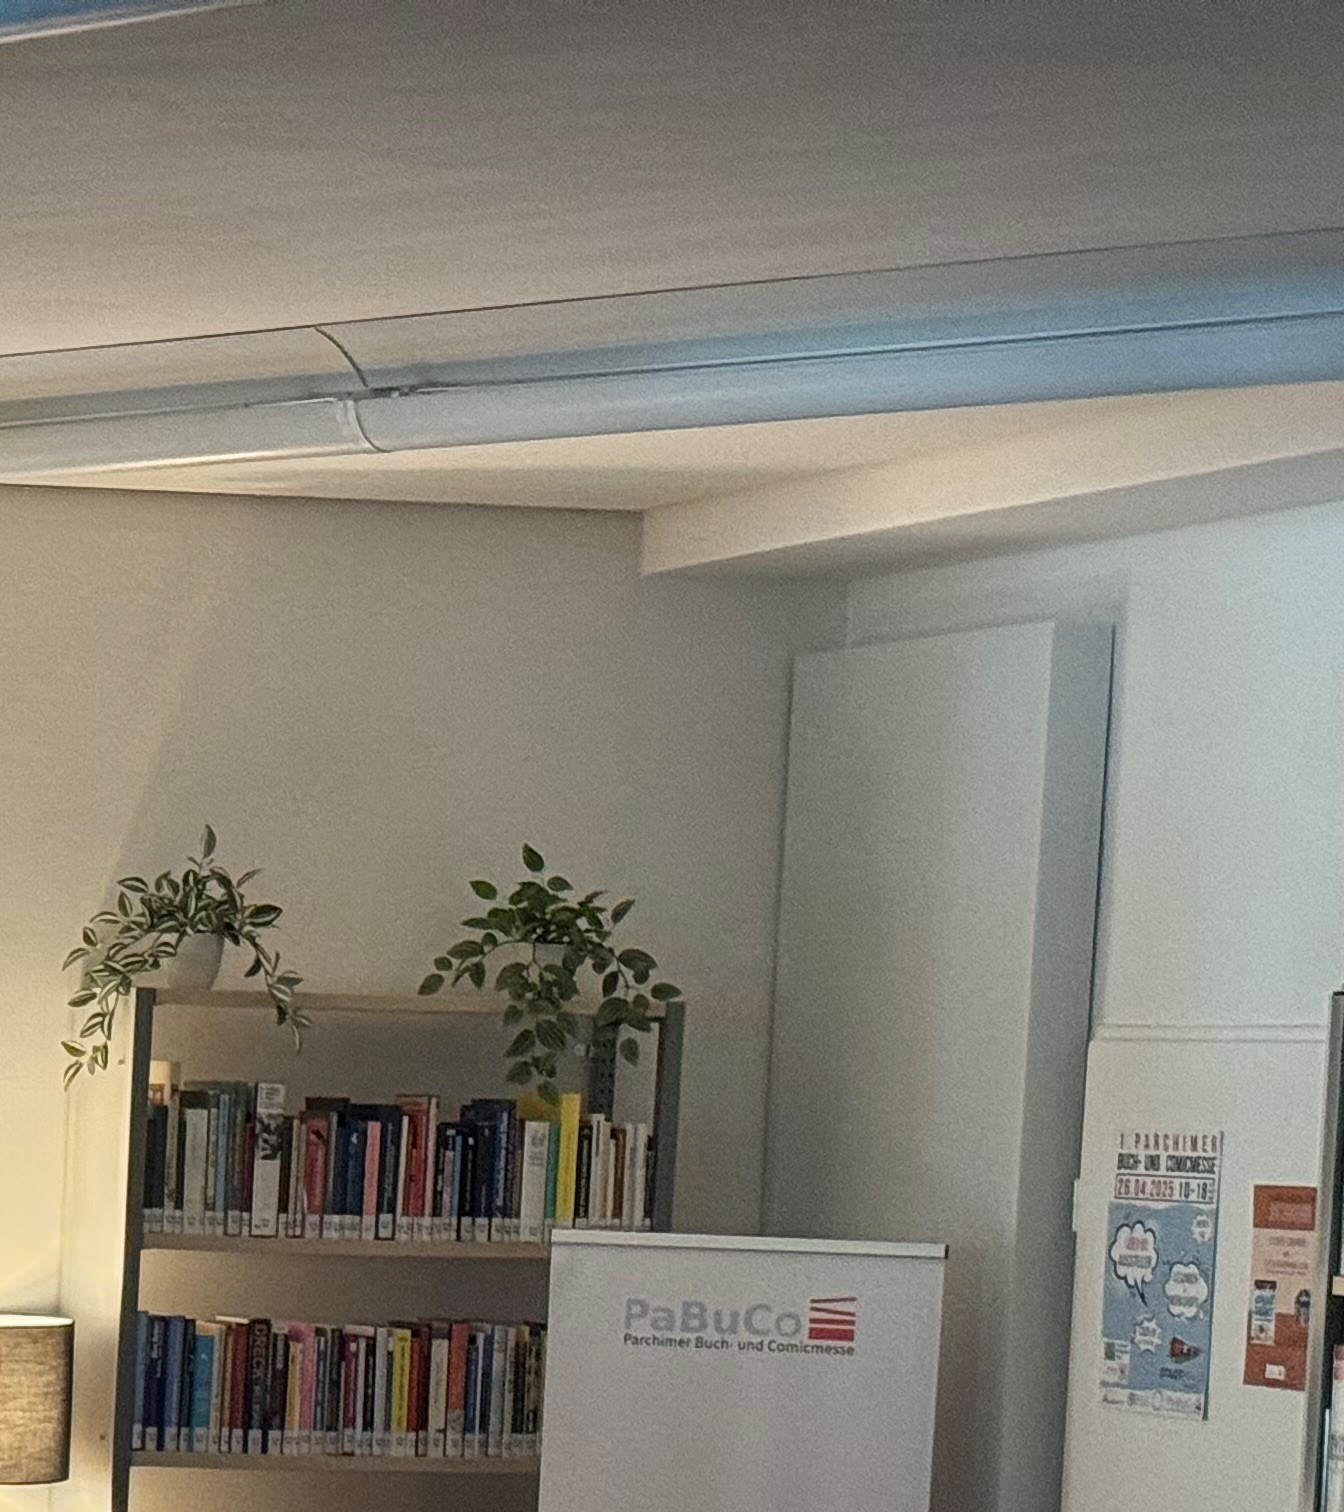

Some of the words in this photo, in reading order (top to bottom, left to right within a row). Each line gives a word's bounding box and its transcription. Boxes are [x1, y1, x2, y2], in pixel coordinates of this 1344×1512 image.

[1134, 1132, 1218, 1153] PARCHIMER
[623, 1296, 802, 1338] PaBuCo
[623, 1334, 691, 1350] Parchimer
[695, 1336, 734, 1350] Buch-
[737, 1338, 764, 1352] und
[767, 1340, 855, 1356] Comicmesse
